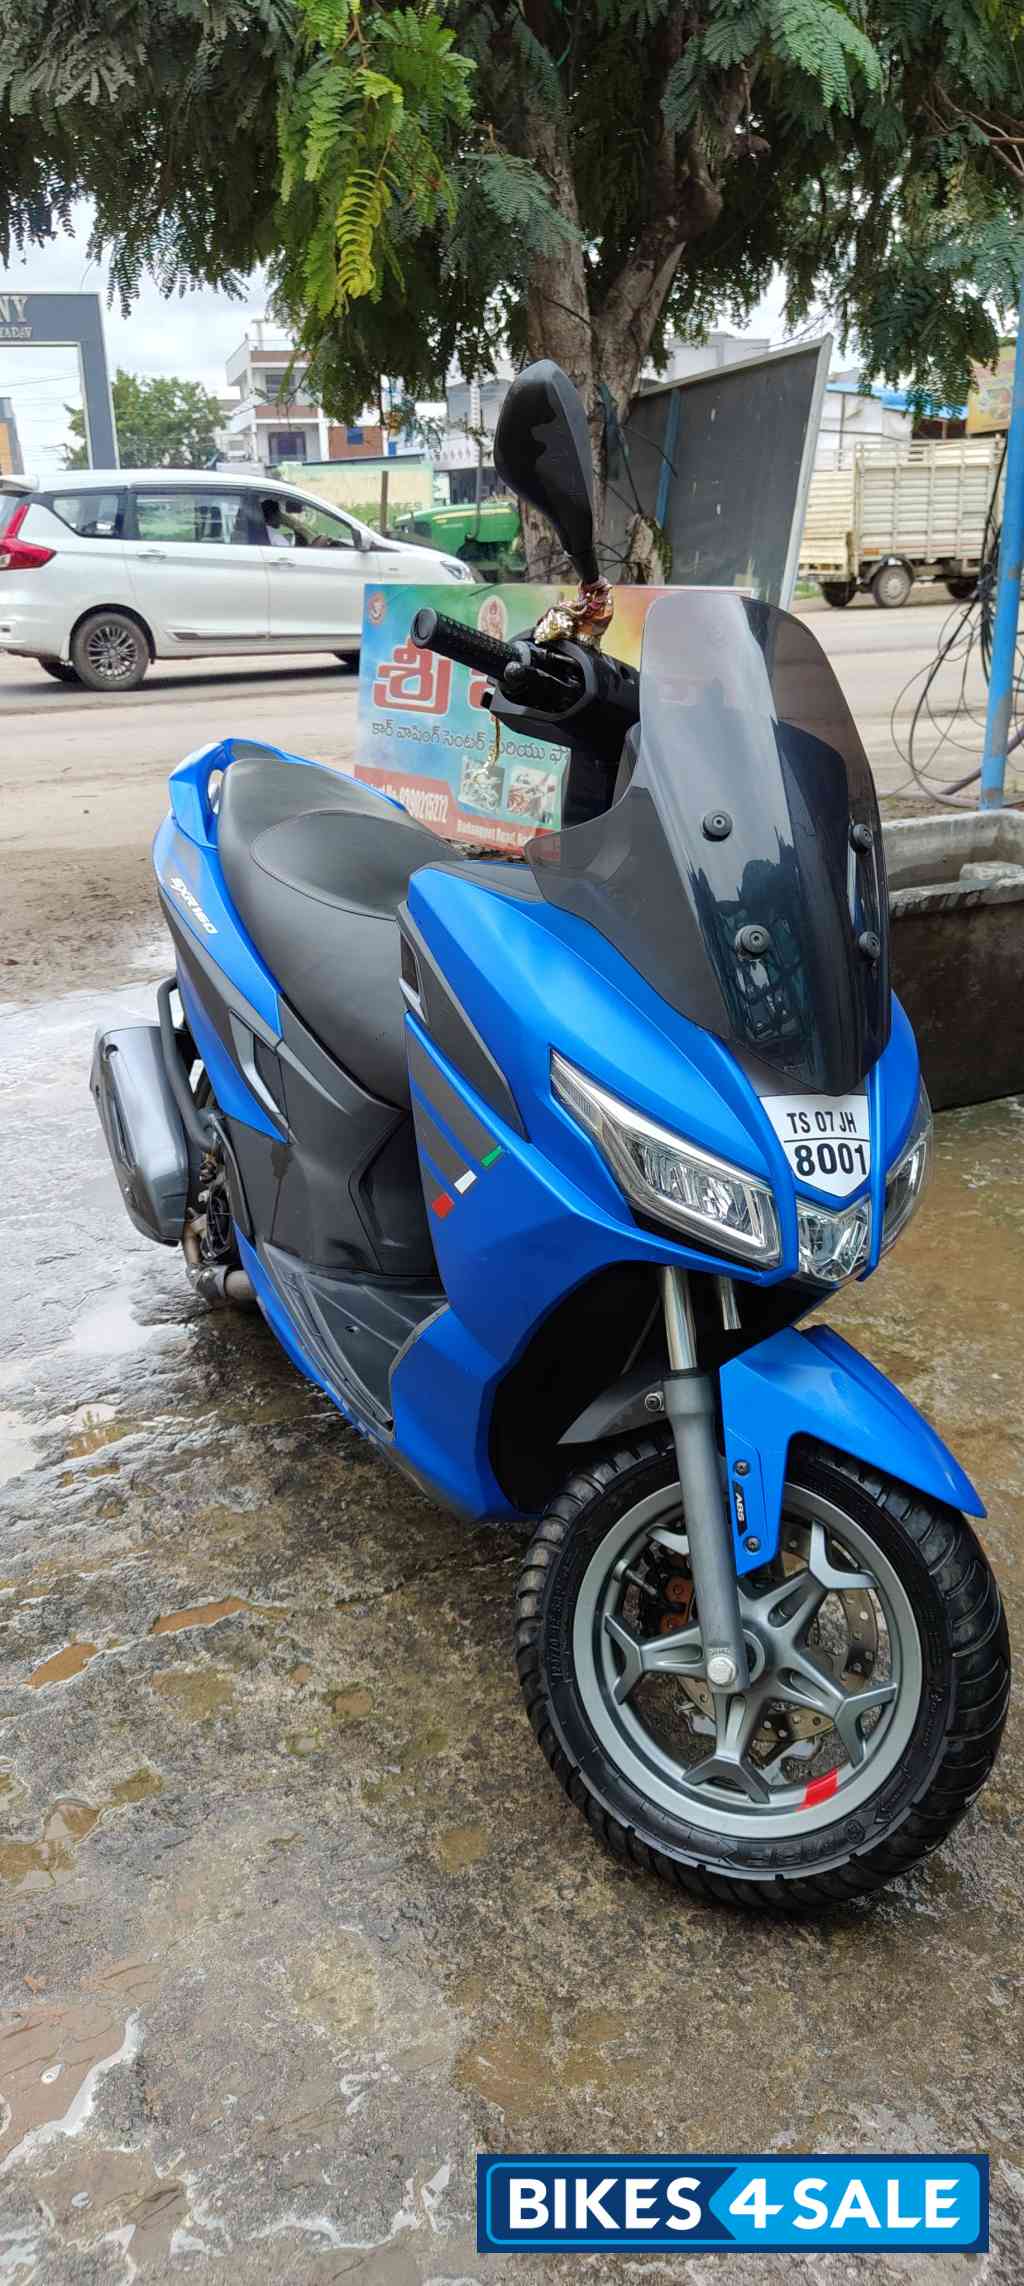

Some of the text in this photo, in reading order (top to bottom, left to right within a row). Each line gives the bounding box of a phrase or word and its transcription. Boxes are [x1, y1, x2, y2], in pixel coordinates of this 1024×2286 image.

[787, 1111, 857, 1134] TS 07 JH
[794, 1143, 867, 1177] 8001
[735, 1493, 745, 1522] ABS
